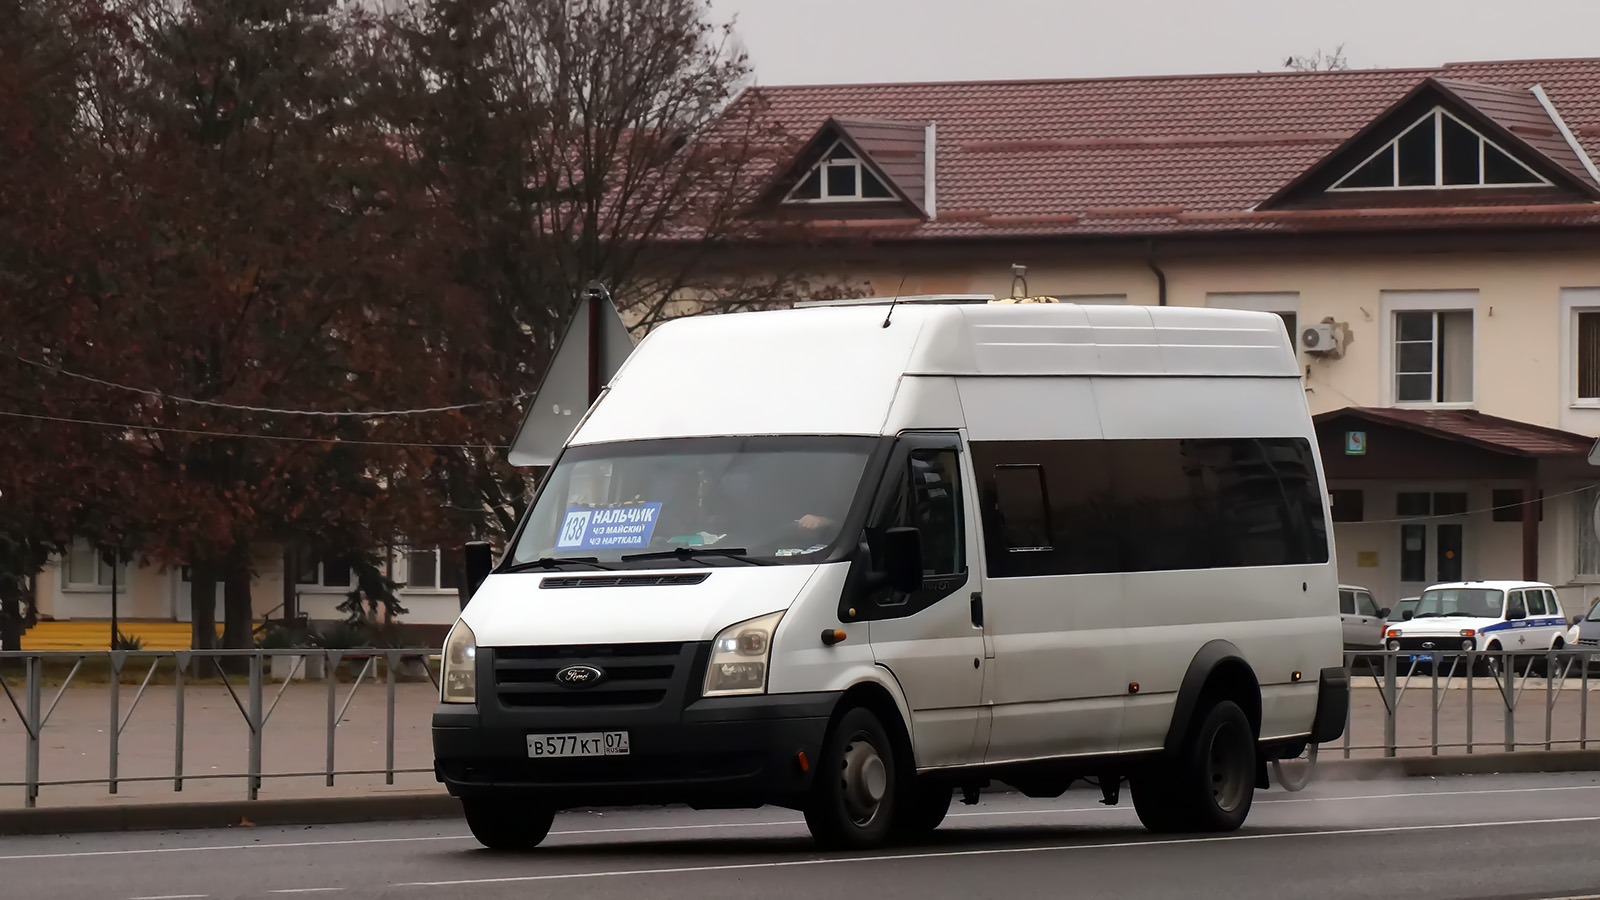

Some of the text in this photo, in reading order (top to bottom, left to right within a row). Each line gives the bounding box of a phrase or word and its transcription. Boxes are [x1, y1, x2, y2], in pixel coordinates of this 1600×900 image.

[592, 508, 656, 524] НАЛЬЧИК
[563, 517, 586, 541] 138
[605, 524, 646, 534] МАЙСКИЙ
[602, 535, 642, 545] НАРТКАЛА
[565, 669, 590, 681] Ford
[605, 733, 622, 748] 07
